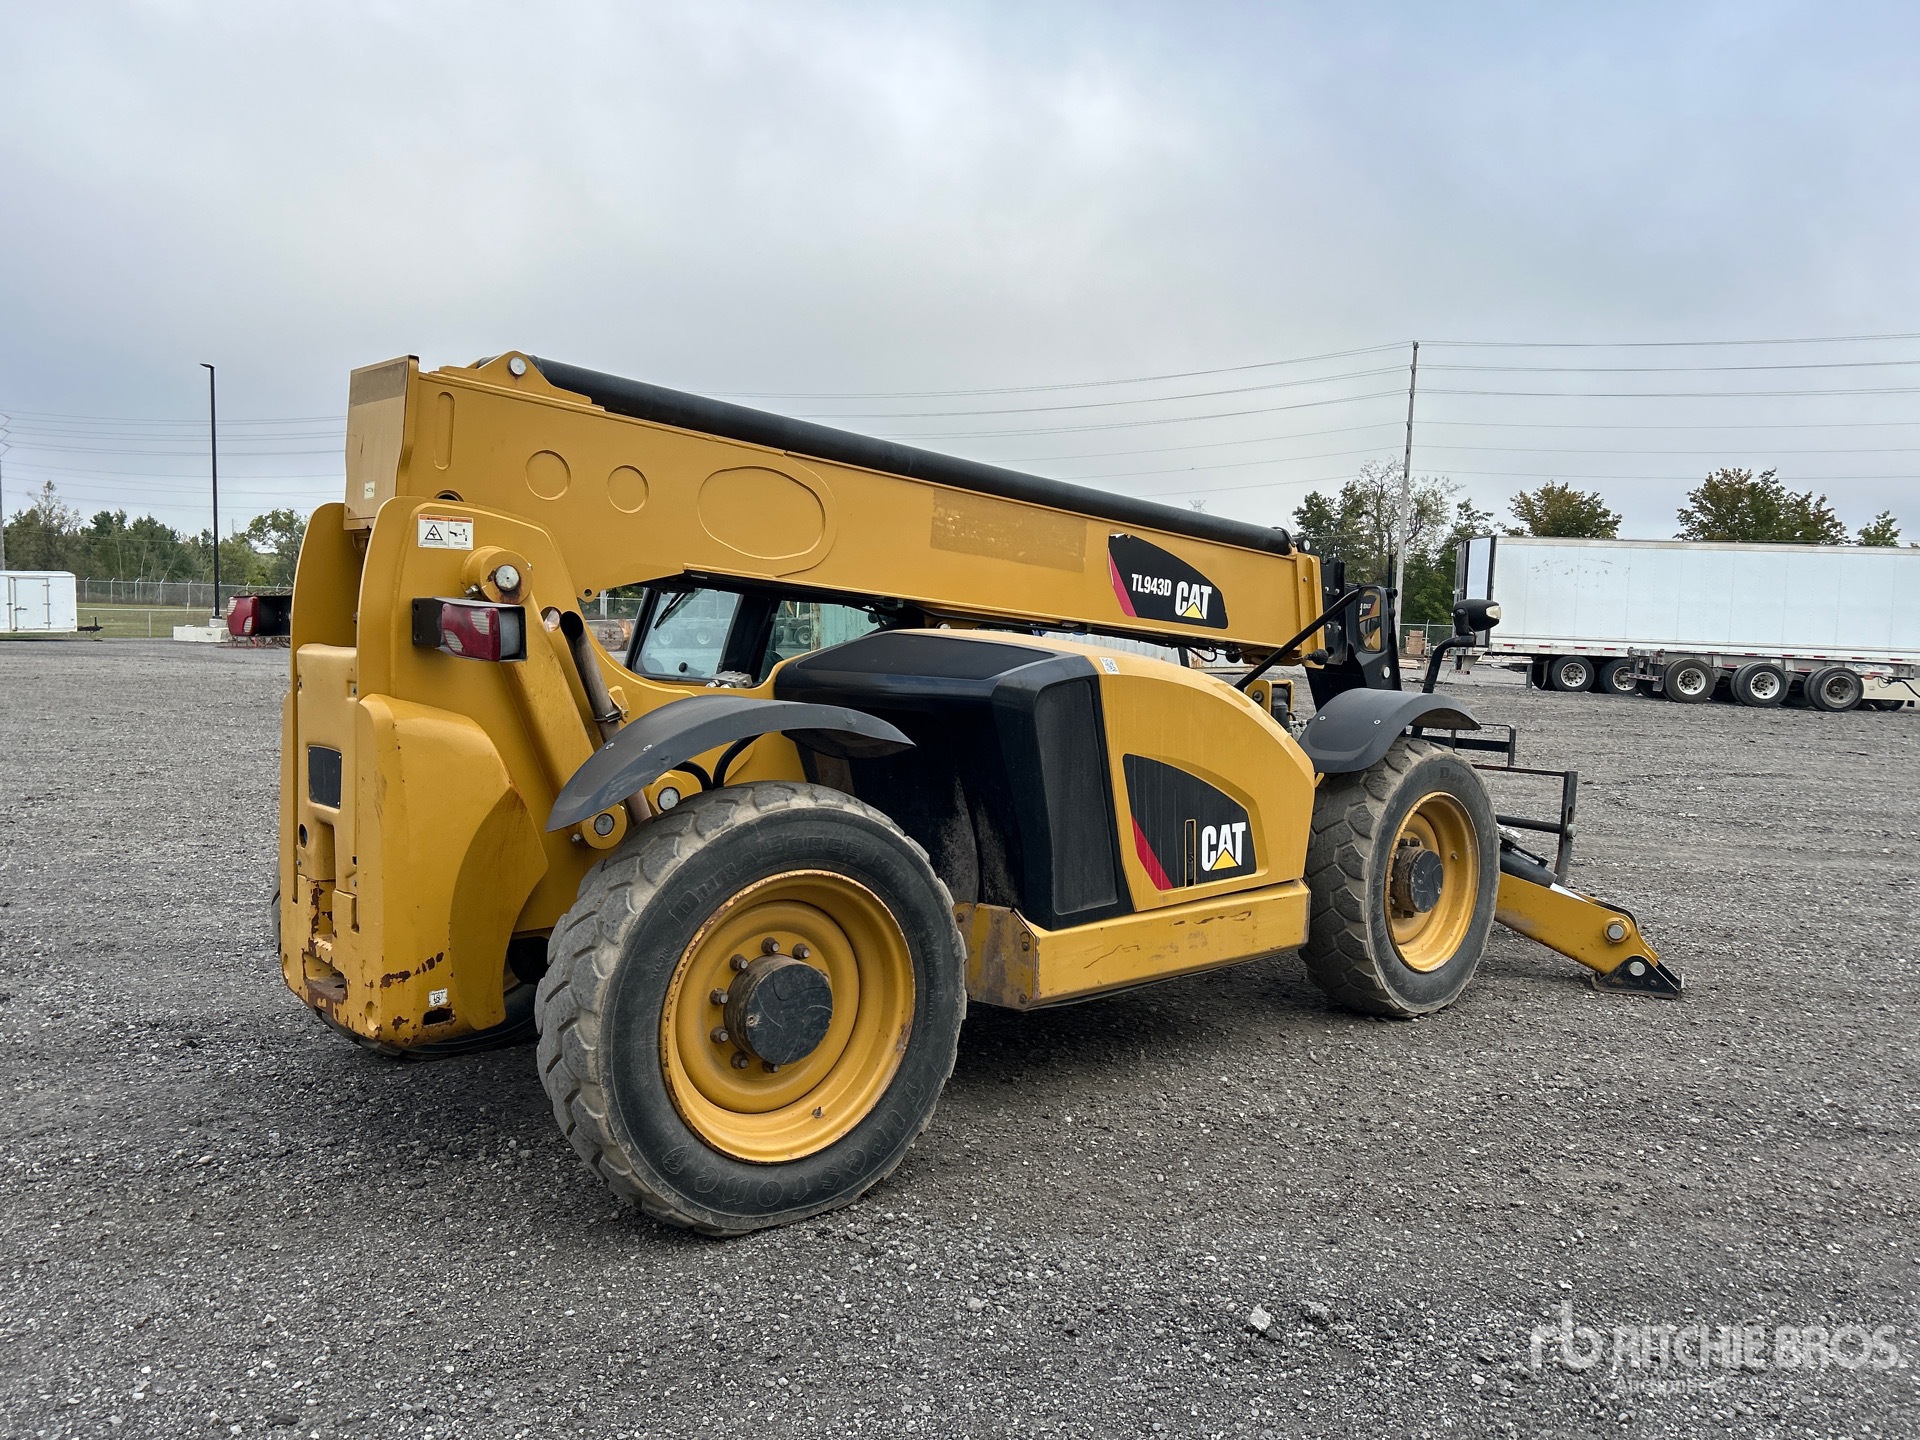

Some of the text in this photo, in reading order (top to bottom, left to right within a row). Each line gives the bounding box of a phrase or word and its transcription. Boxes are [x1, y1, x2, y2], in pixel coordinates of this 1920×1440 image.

[1131, 573, 1212, 620] TL943D CAT
[1201, 822, 1246, 872] CAT
